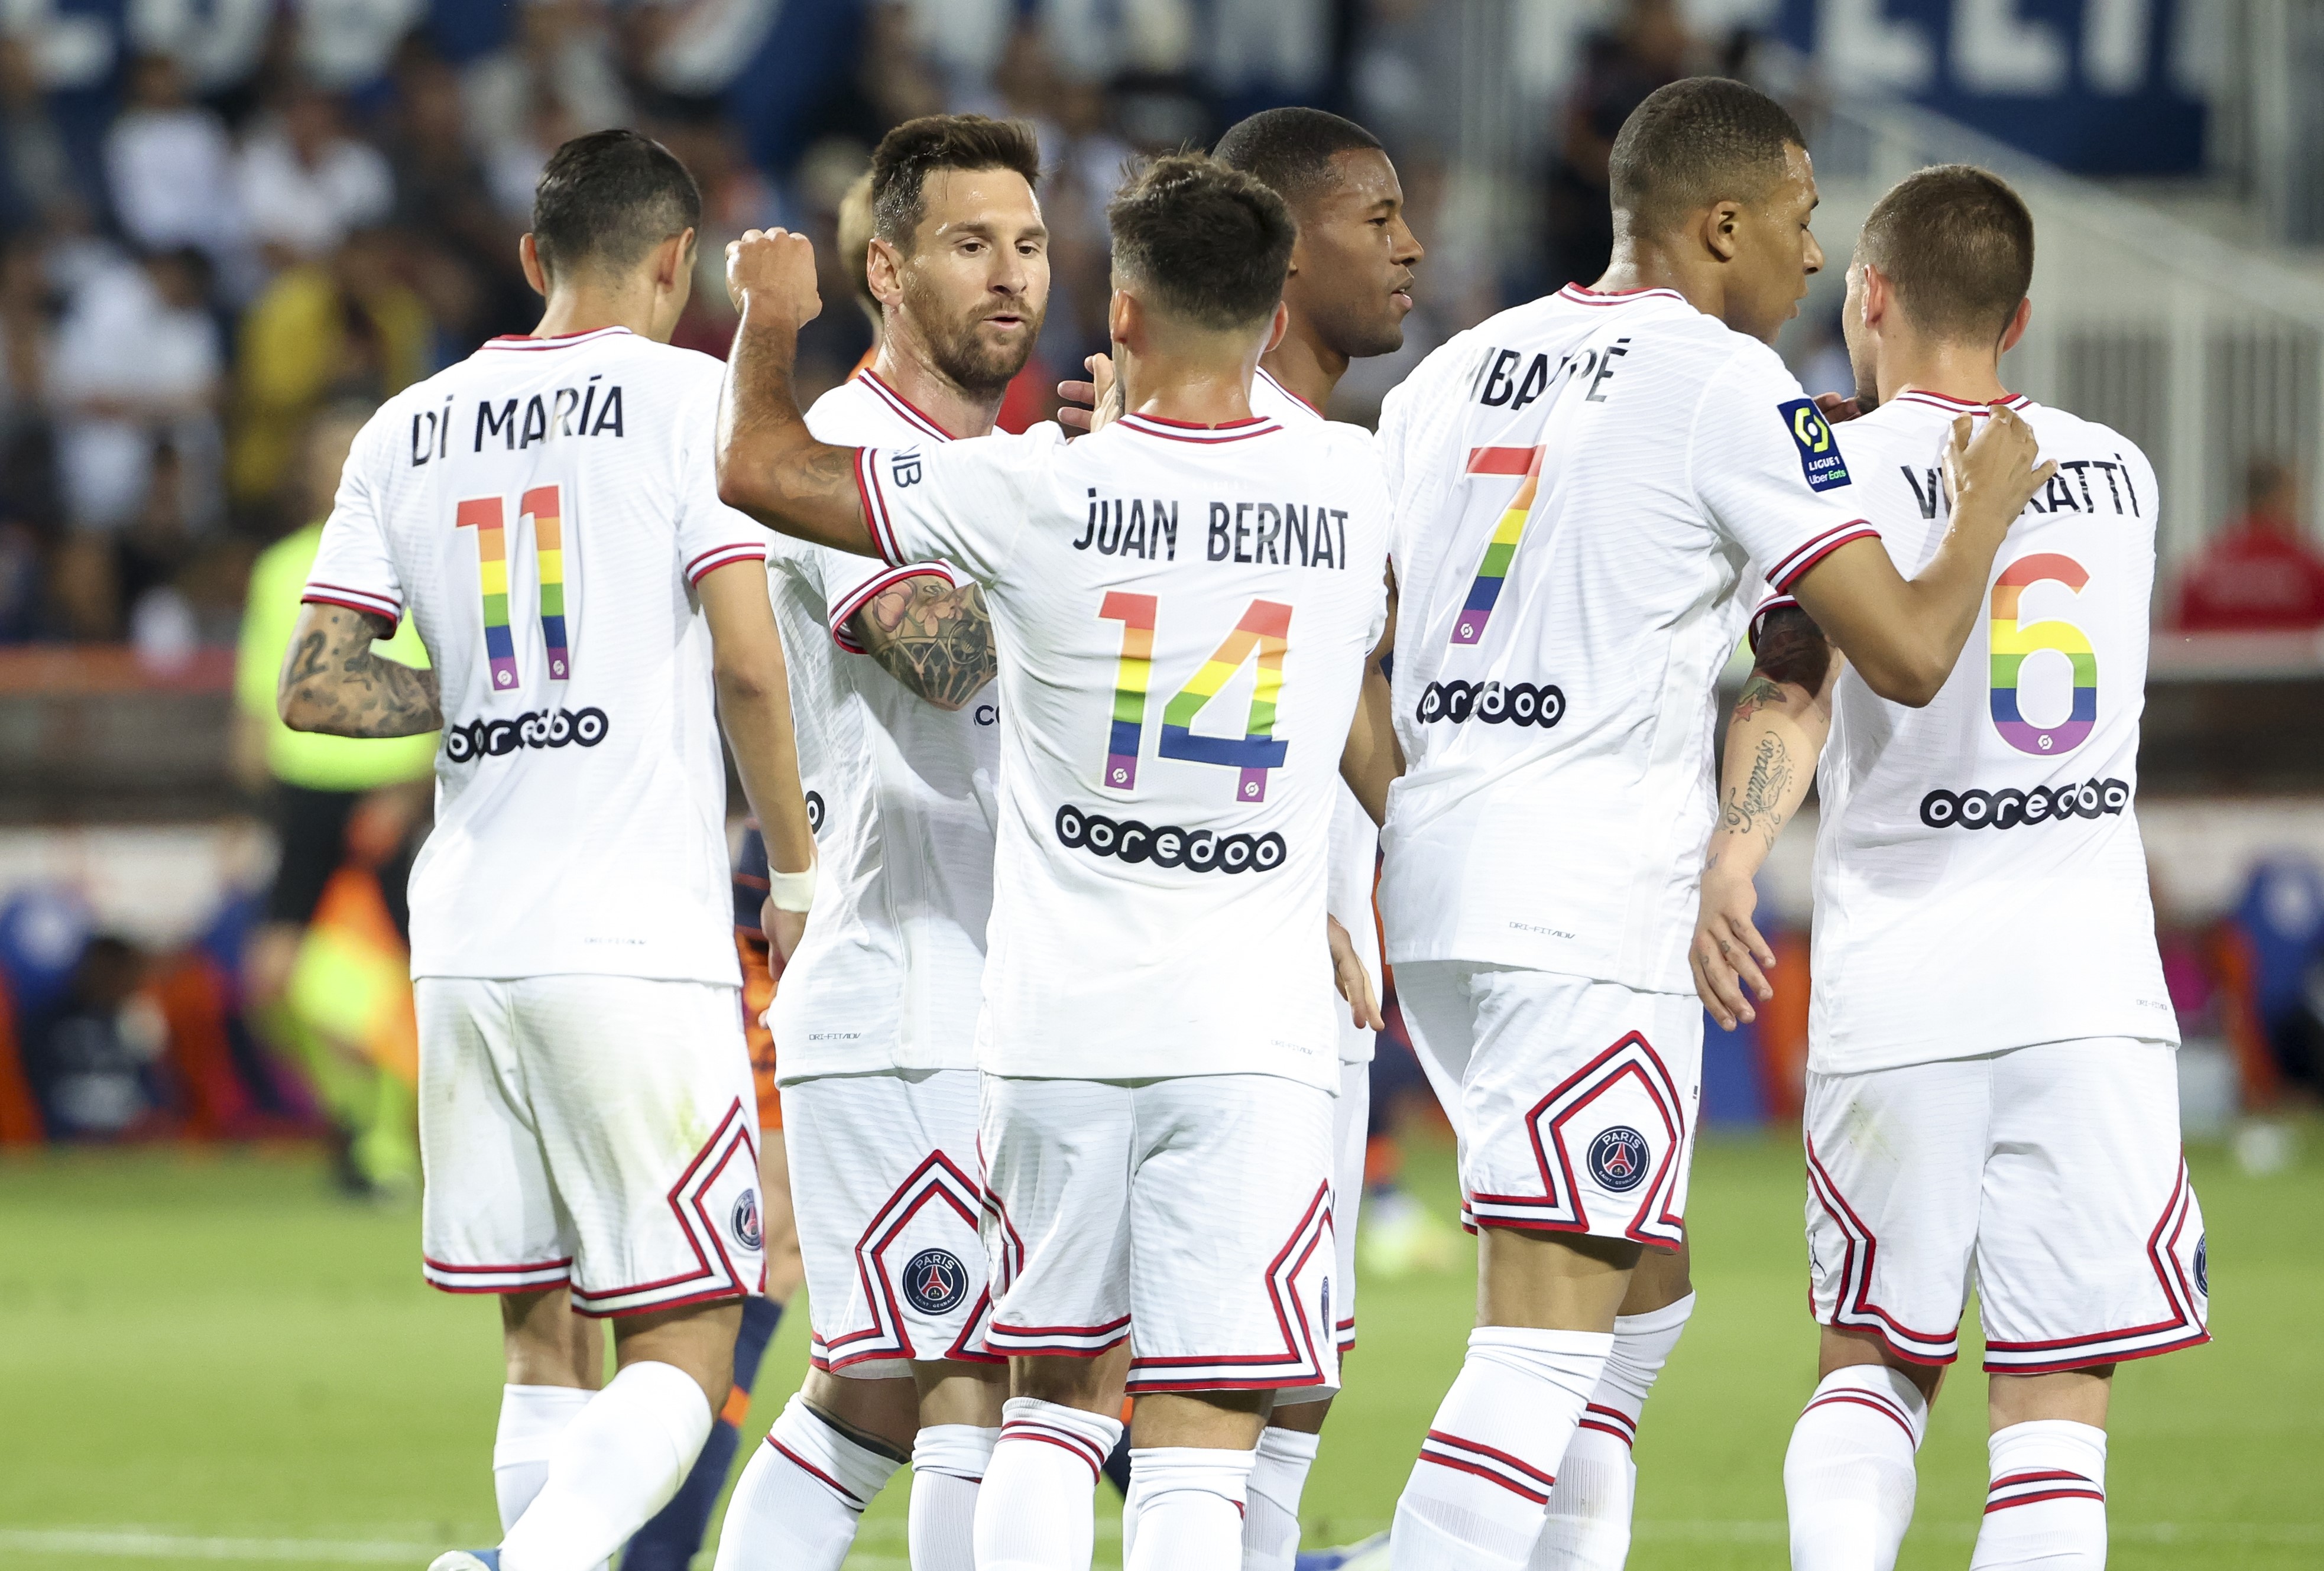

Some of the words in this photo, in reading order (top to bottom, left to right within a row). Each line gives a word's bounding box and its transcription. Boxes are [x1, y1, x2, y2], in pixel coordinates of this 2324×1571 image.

[1453, 337, 1632, 410] MBAPÉ
[474, 374, 623, 452] MARÍA
[1809, 473, 1828, 485] Uber
[1828, 469, 1846, 480] Eats
[1900, 453, 2140, 519] VATTI
[1072, 487, 1178, 561] JUAN
[1207, 502, 1349, 570] BERNAT
[1448, 443, 1548, 645] 7
[456, 485, 569, 692] 11
[1989, 552, 2097, 756] 6
[1097, 590, 1294, 803] 14
[1059, 808, 1283, 869] ooredoo
[1924, 780, 2128, 825] ooredoo
[1602, 1132, 1641, 1149] PARIS
[915, 1254, 955, 1270] PARIS
